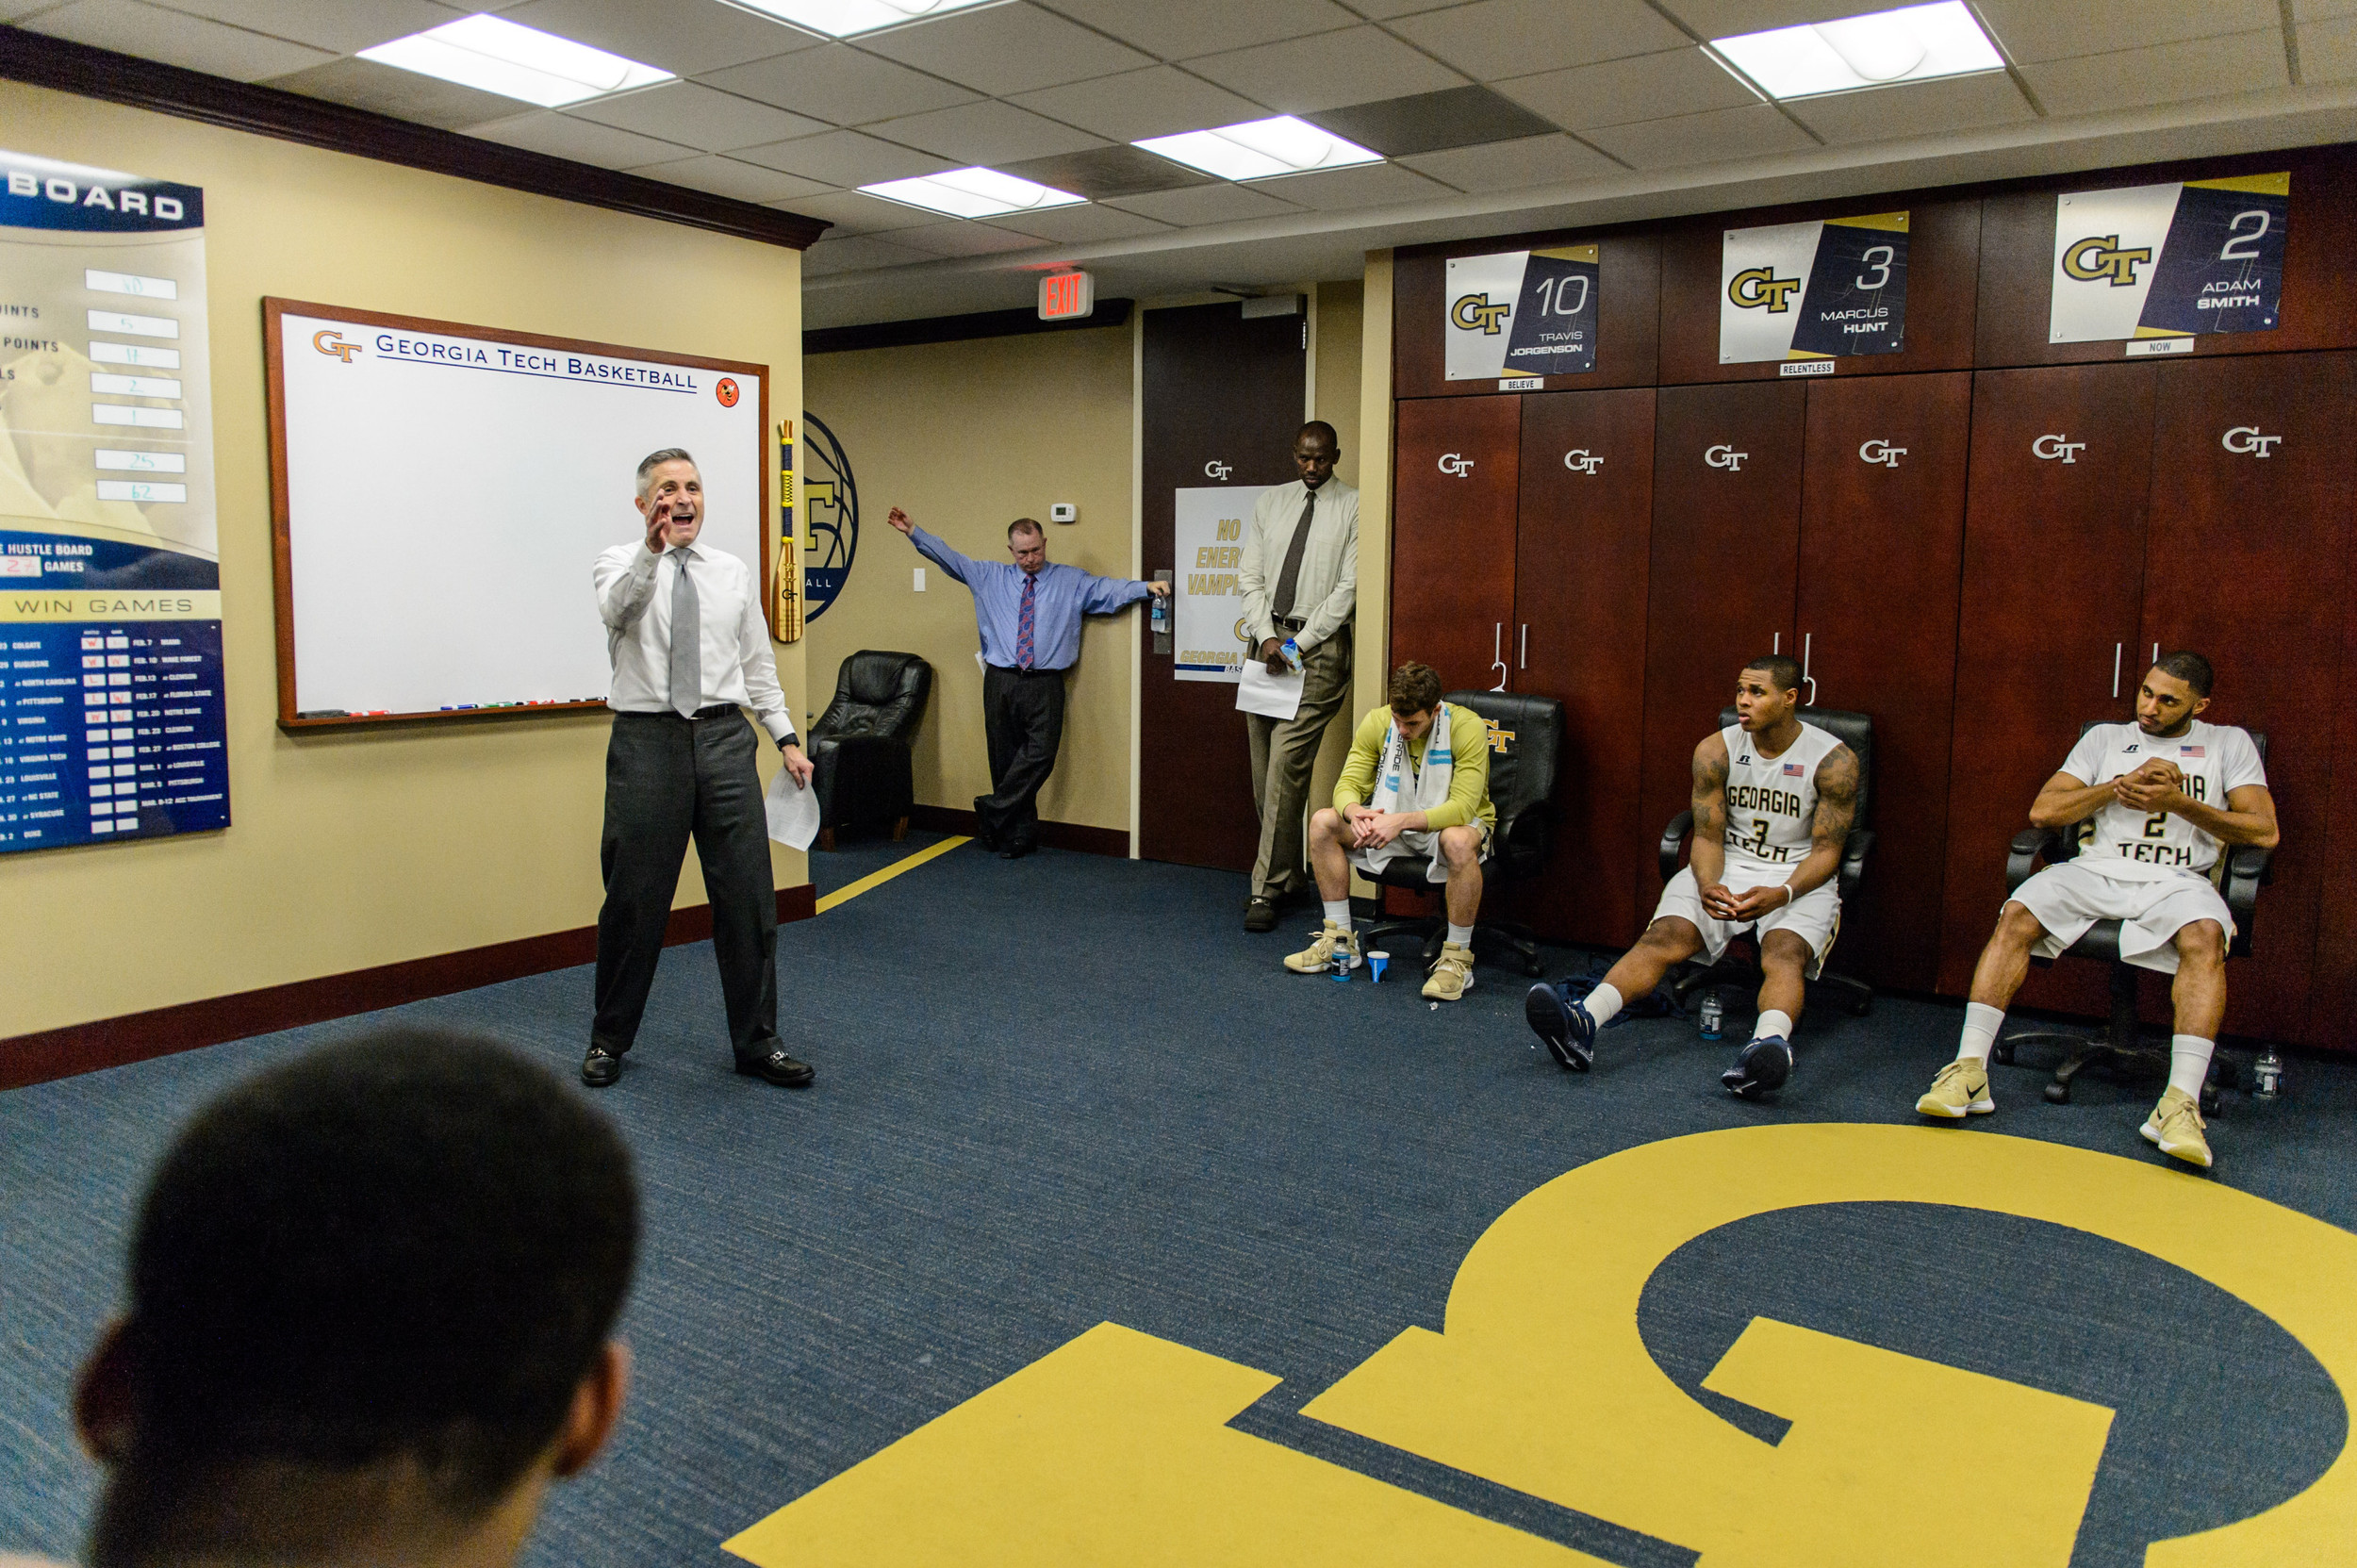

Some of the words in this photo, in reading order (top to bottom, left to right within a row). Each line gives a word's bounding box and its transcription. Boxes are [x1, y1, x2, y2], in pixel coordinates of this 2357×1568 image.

[8, 171, 184, 221] BOARD
[2220, 210, 2270, 260] 2
[1856, 245, 1894, 290] 3
[2201, 279, 2261, 293] ADAM
[1047, 273, 1081, 316] EXIT
[1536, 275, 1589, 317] 10
[2197, 295, 2260, 309] SMITH
[1821, 307, 1888, 322] MARCUS
[1843, 322, 1888, 334] HUNT
[1539, 331, 1583, 341] TRAVIS
[4, 337, 58, 353] POINTS
[1510, 344, 1583, 356] JORGENSON
[2150, 342, 2171, 353] NOW
[376, 335, 487, 364] GEORGIA
[498, 349, 556, 372] TECH
[568, 358, 697, 388] BASKETBALL
[1783, 363, 1832, 374] RELENTLESS
[1508, 380, 1535, 389] BELIEVE
[1216, 519, 1241, 541] NO
[8, 544, 52, 554] HUSTLE
[55, 544, 93, 555] BOARD
[1196, 547, 1244, 569] ENER
[44, 561, 84, 572] GAMES
[15, 600, 72, 614] WIN
[90, 599, 192, 614] GAMES
[1180, 650, 1237, 665] GEORGIA
[1728, 786, 1800, 818] GEORGIA
[1753, 818, 1770, 844] 3
[2143, 811, 2167, 838] 2
[2118, 843, 2191, 866] TECH
